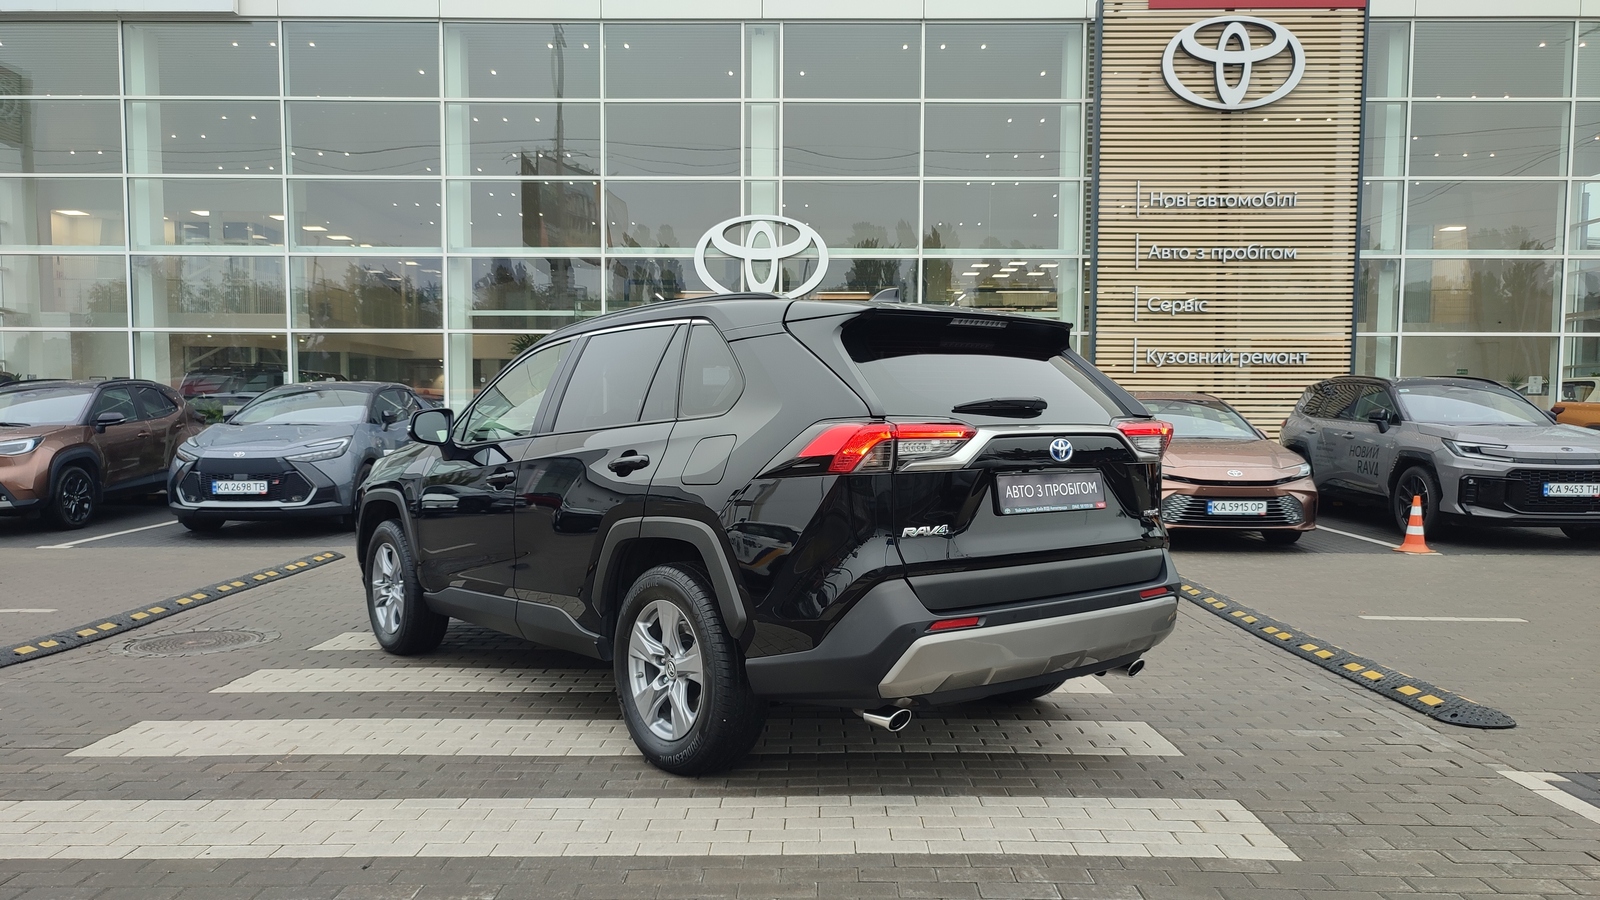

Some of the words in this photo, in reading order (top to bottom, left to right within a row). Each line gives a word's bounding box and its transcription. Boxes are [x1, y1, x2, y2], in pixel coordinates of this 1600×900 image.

[1149, 191, 1191, 207] Нові
[1196, 191, 1298, 207] автомобілі
[1147, 244, 1191, 260] Авто
[1195, 247, 1205, 260] з
[1211, 244, 1297, 264] пробігом
[1147, 297, 1209, 316] Сервіс
[1146, 348, 1234, 368] Кузовний
[1239, 352, 1310, 368] ремонт
[1349, 444, 1380, 459] НОВИЙ
[1357, 460, 1379, 478] RAV4
[1005, 484, 1035, 499] АВТО
[1044, 481, 1098, 497] ПРОБІГОМ
[901, 524, 949, 538] RAV4
[659, 731, 704, 766] BRIDGESTONE
